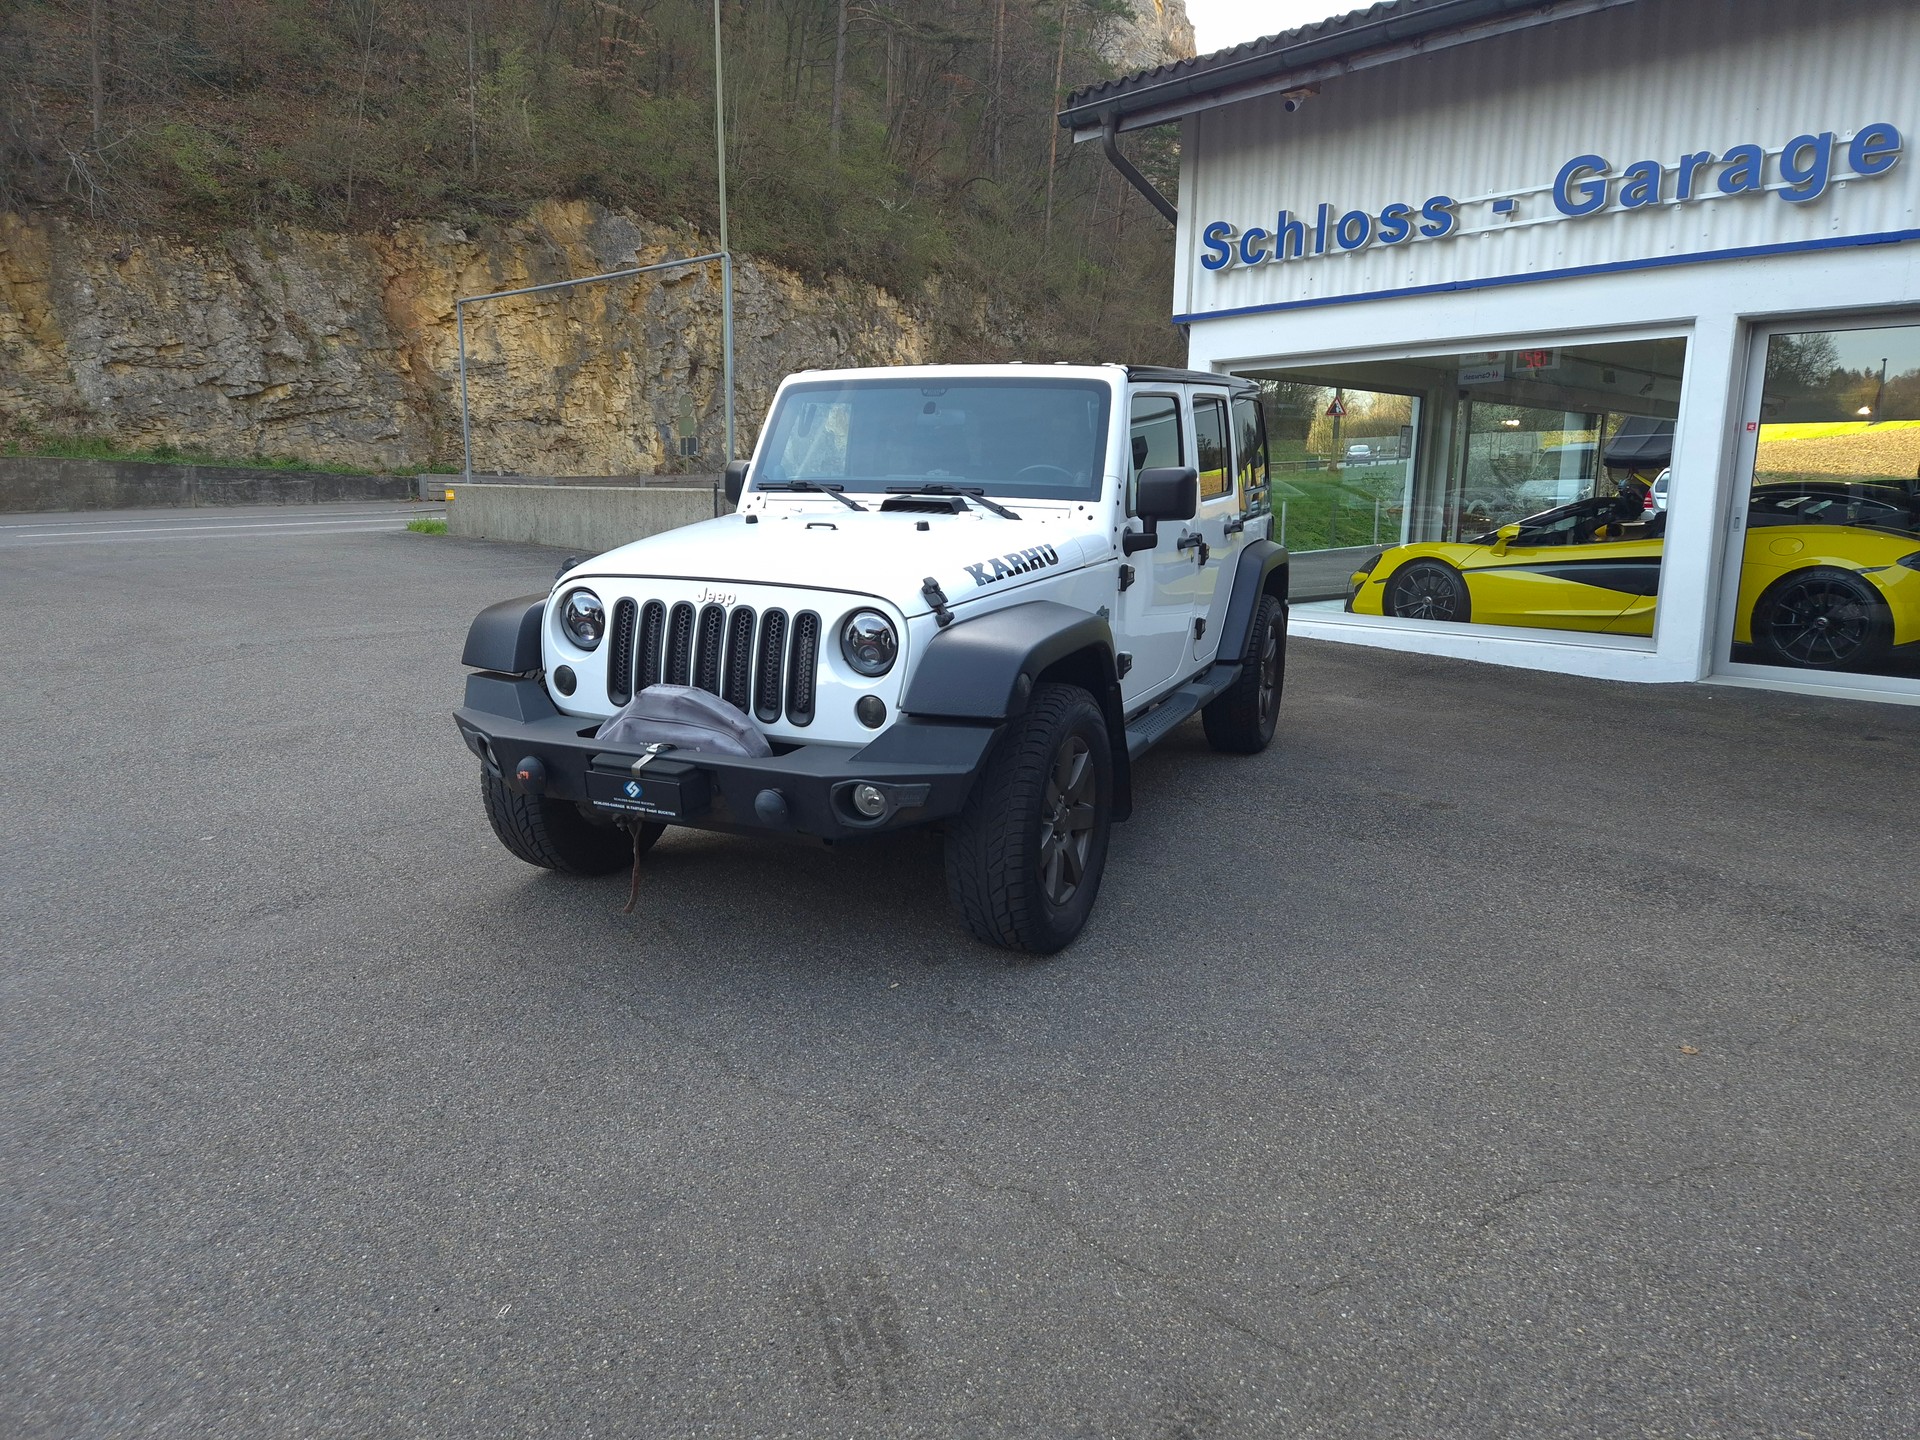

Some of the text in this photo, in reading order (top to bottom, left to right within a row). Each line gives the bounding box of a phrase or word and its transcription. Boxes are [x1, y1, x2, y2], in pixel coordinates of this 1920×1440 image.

[1201, 195, 1460, 272] Schloss
[1552, 122, 1904, 217] Garage
[963, 543, 1059, 587] KARHU
[696, 587, 736, 607] Jeep
